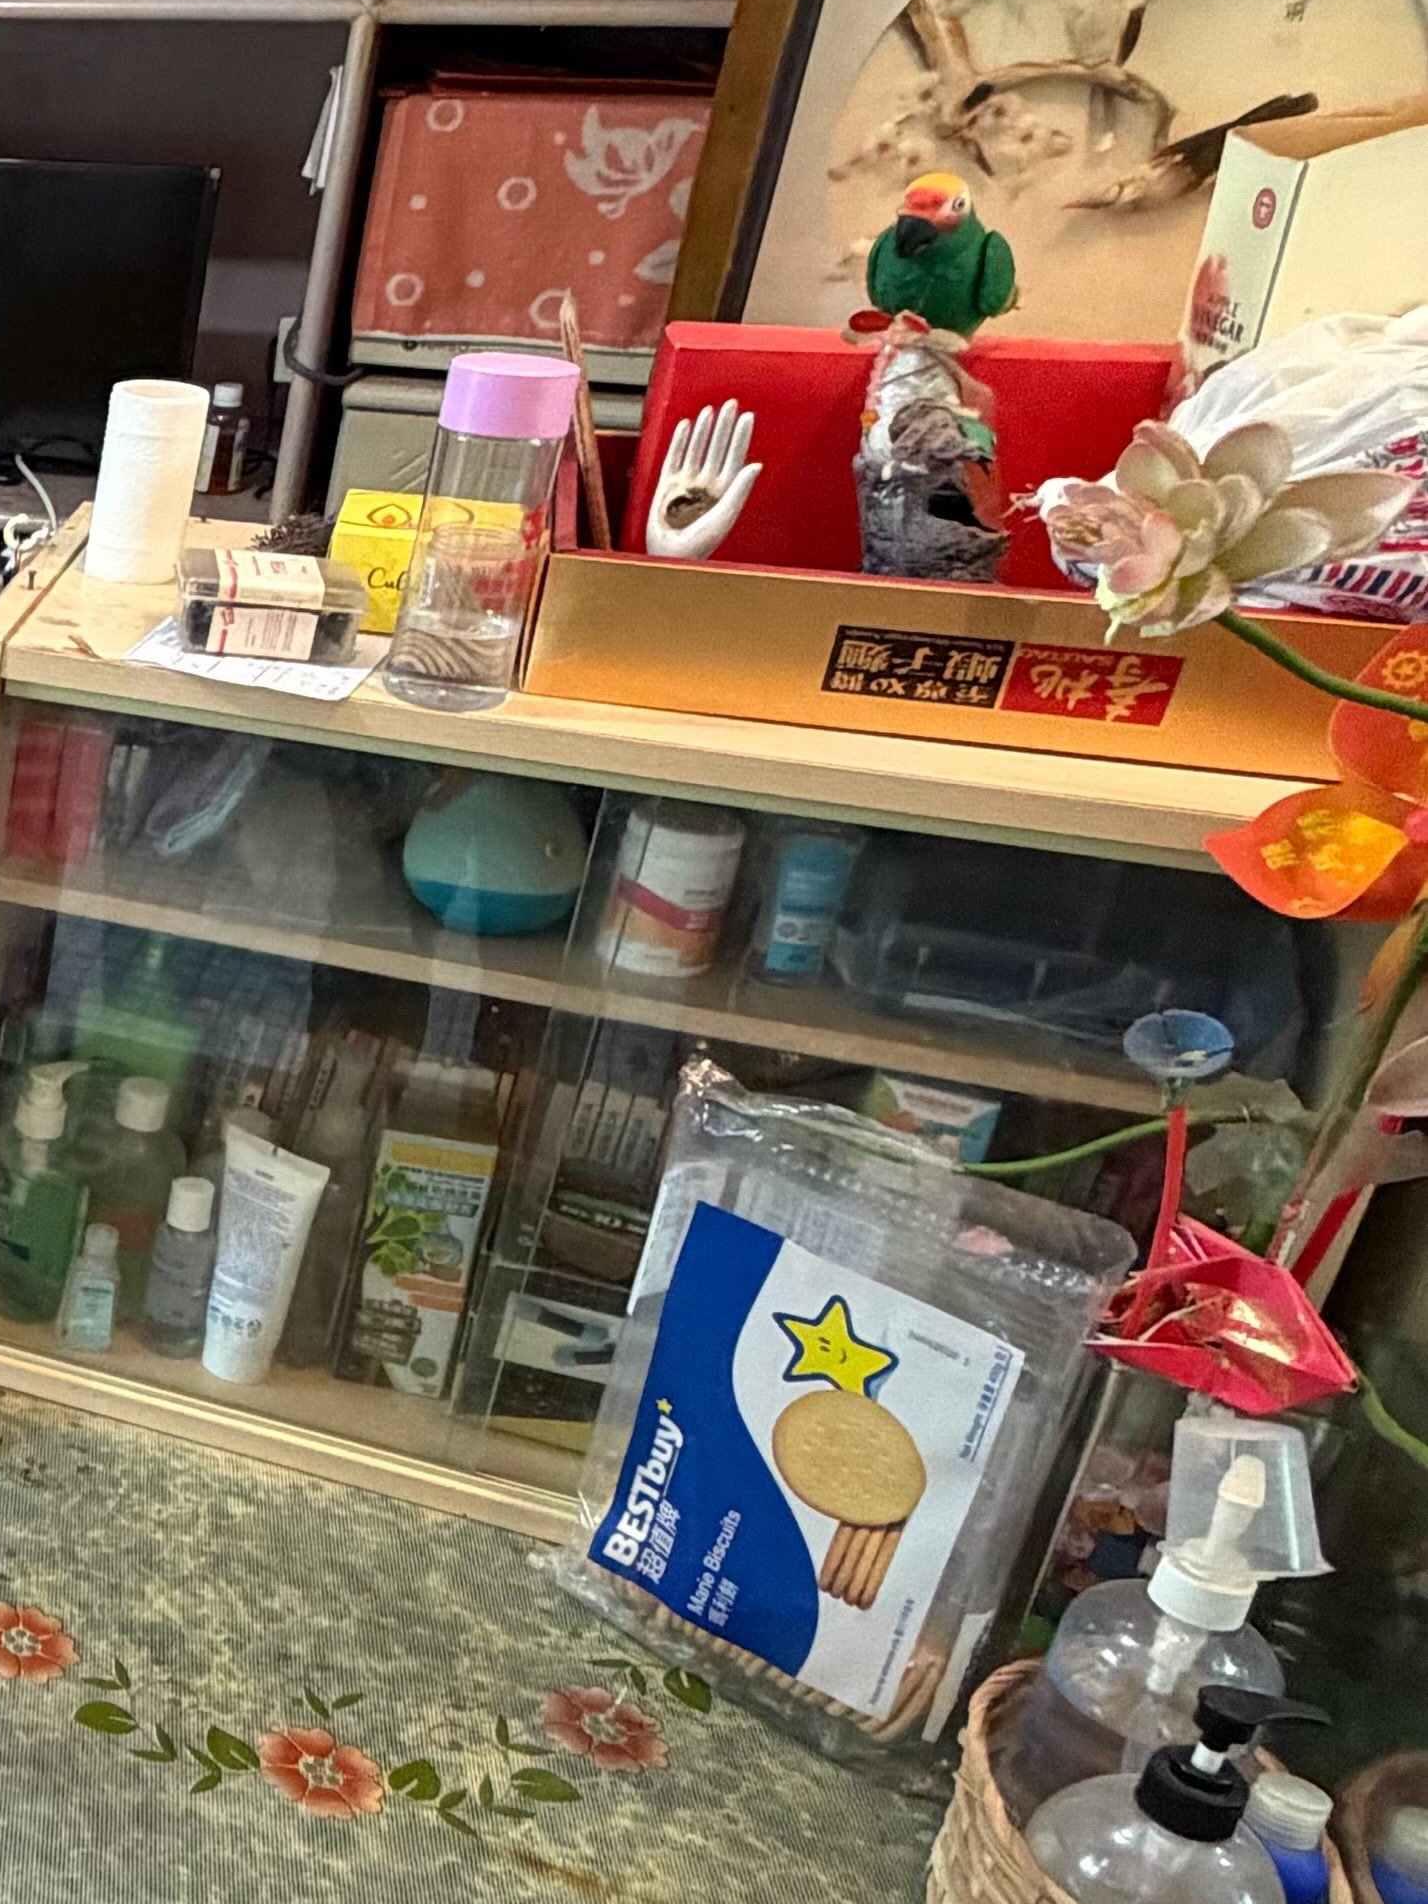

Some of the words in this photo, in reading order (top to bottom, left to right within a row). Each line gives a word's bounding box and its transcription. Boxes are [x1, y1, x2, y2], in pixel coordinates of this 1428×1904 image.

[602, 1409, 685, 1567] BESTbuy
[635, 1498, 682, 1585] 超值牌
[686, 1569, 718, 1616] Marie
[702, 1508, 742, 1572] Biscuits
